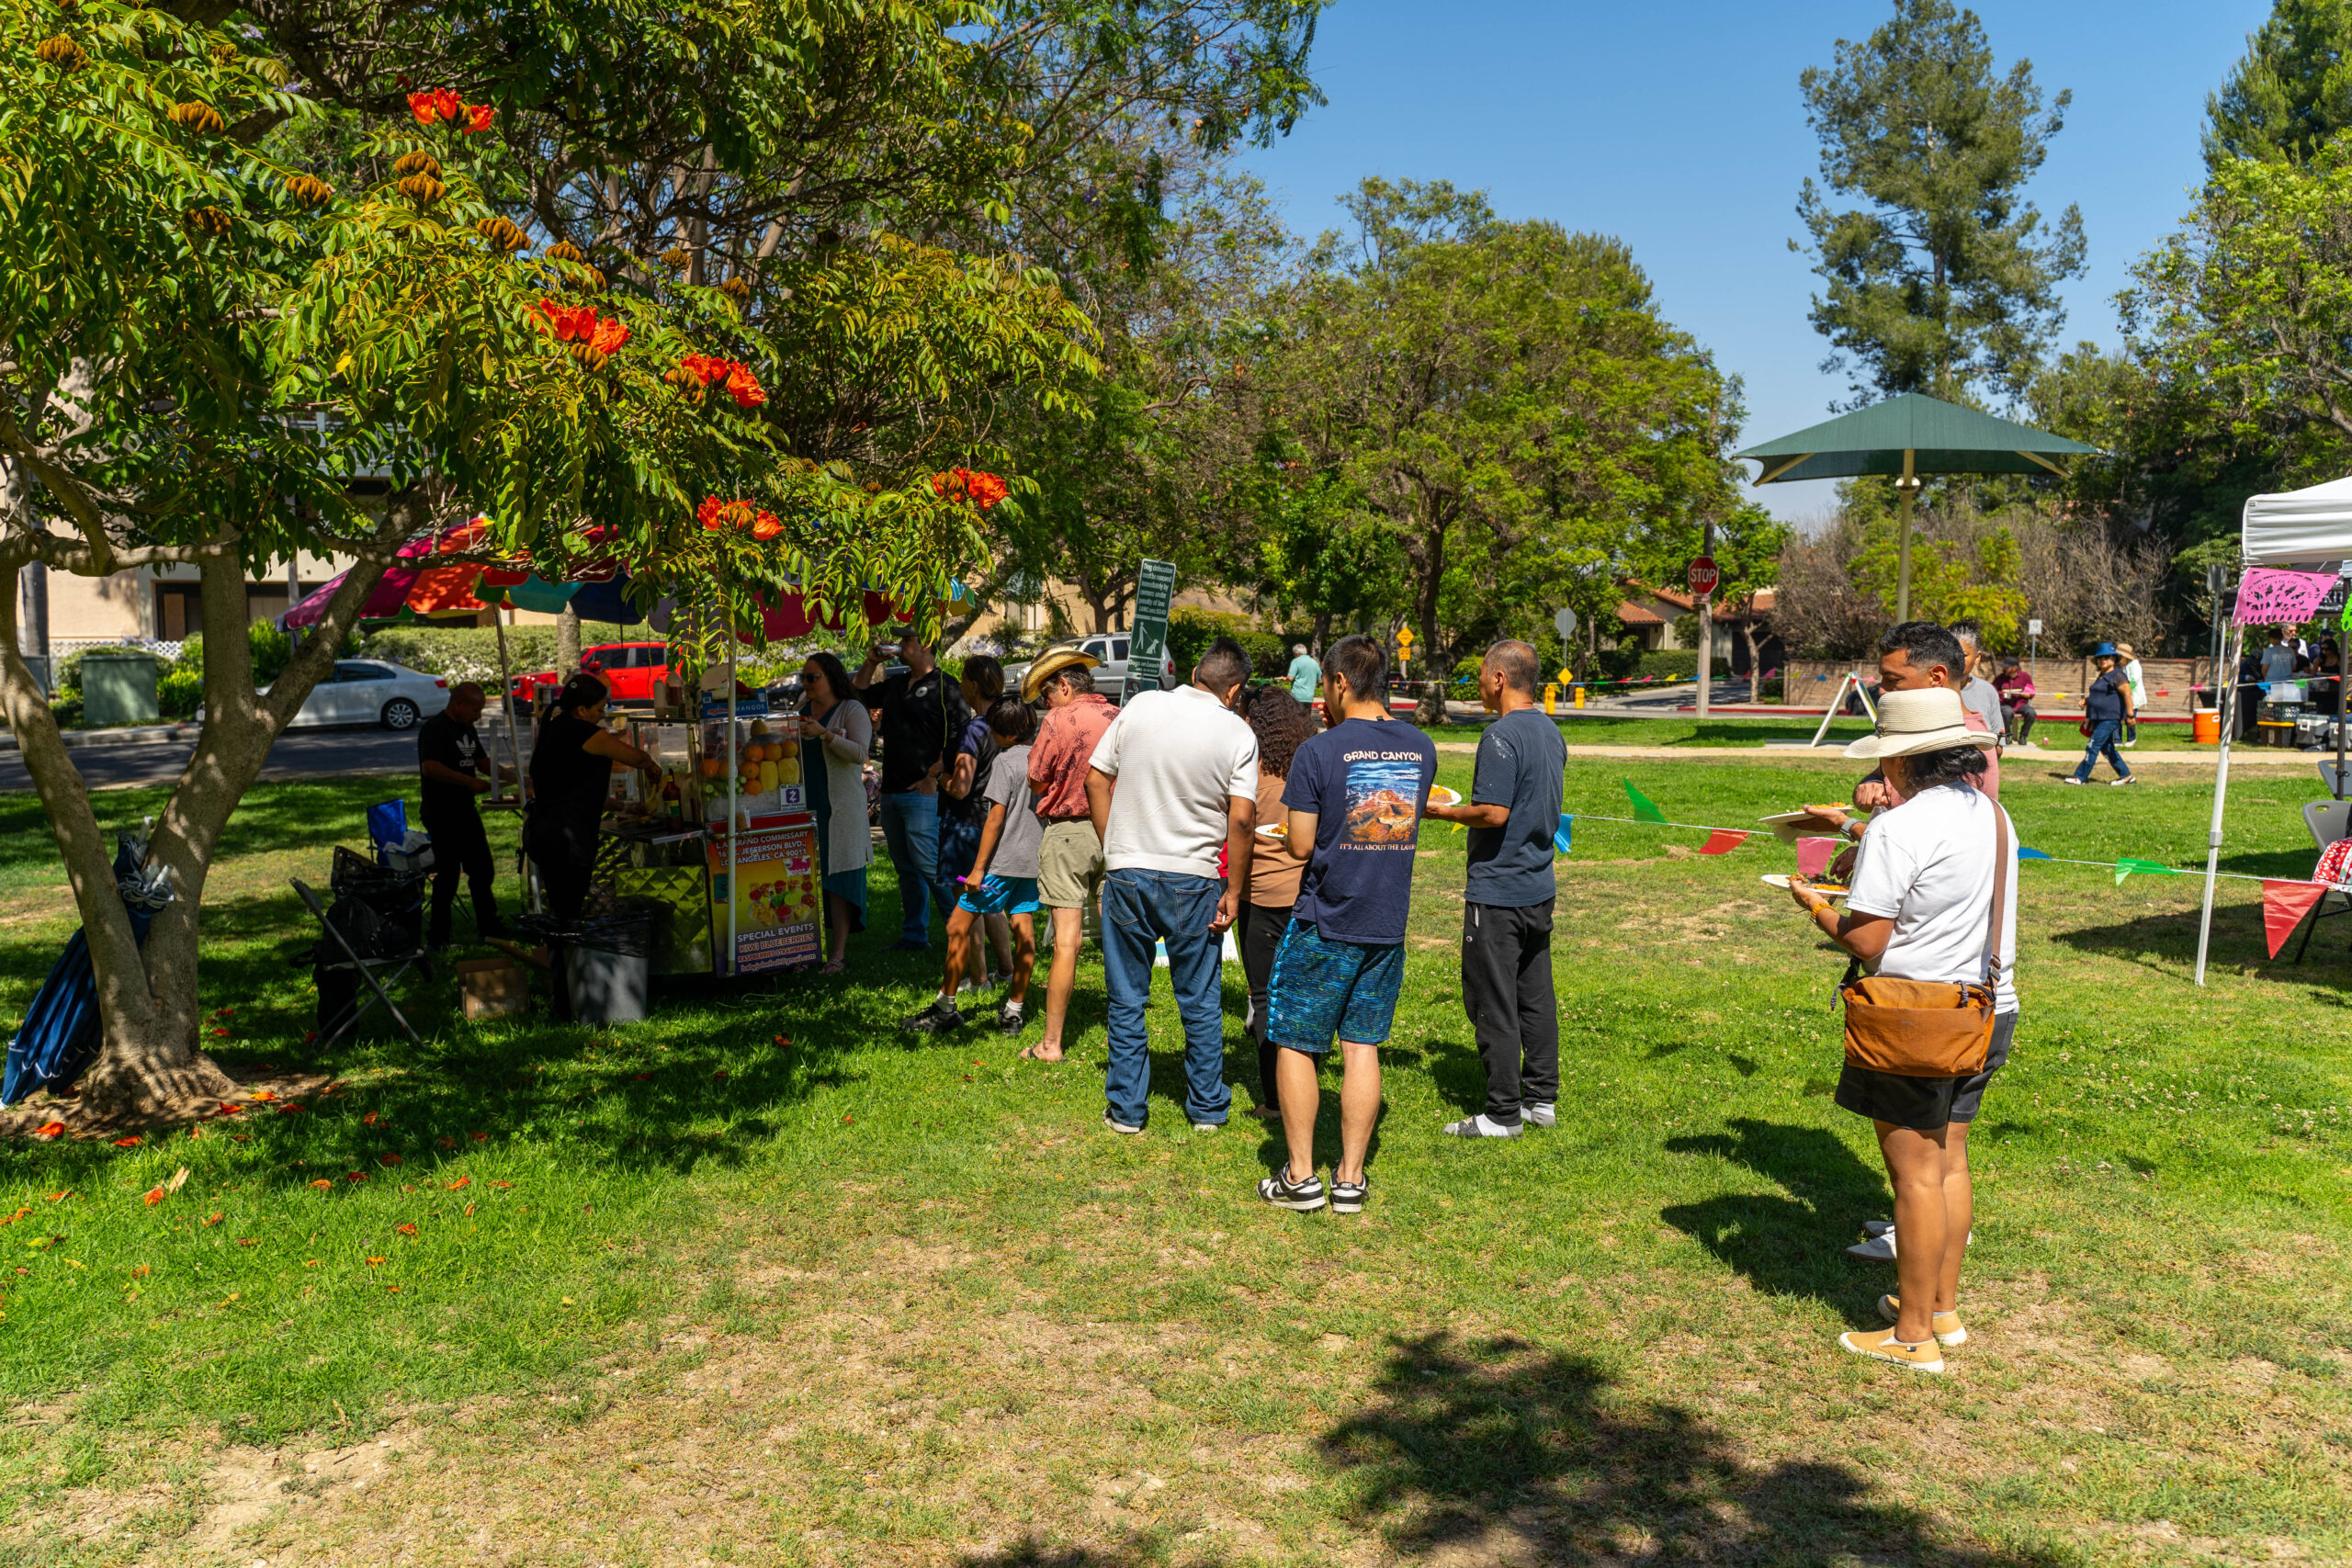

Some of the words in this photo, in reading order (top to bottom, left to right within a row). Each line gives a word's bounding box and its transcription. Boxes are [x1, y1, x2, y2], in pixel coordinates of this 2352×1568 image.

[1690, 568, 1716, 582] STOP
[1343, 750, 1378, 761] GRAND
[1381, 751, 1422, 761] CANYON
[761, 830, 808, 843] COMMISSARY
[742, 843, 782, 854] JEFFERSON
[738, 930, 775, 942] SPECIAL
[778, 922, 814, 935] EVENTS
[739, 942, 759, 953] KIWI
[761, 933, 814, 949] BLUEBERRIES
[738, 950, 775, 963] RASPBERRIES
[775, 942, 817, 955] STRAWBERRIES
